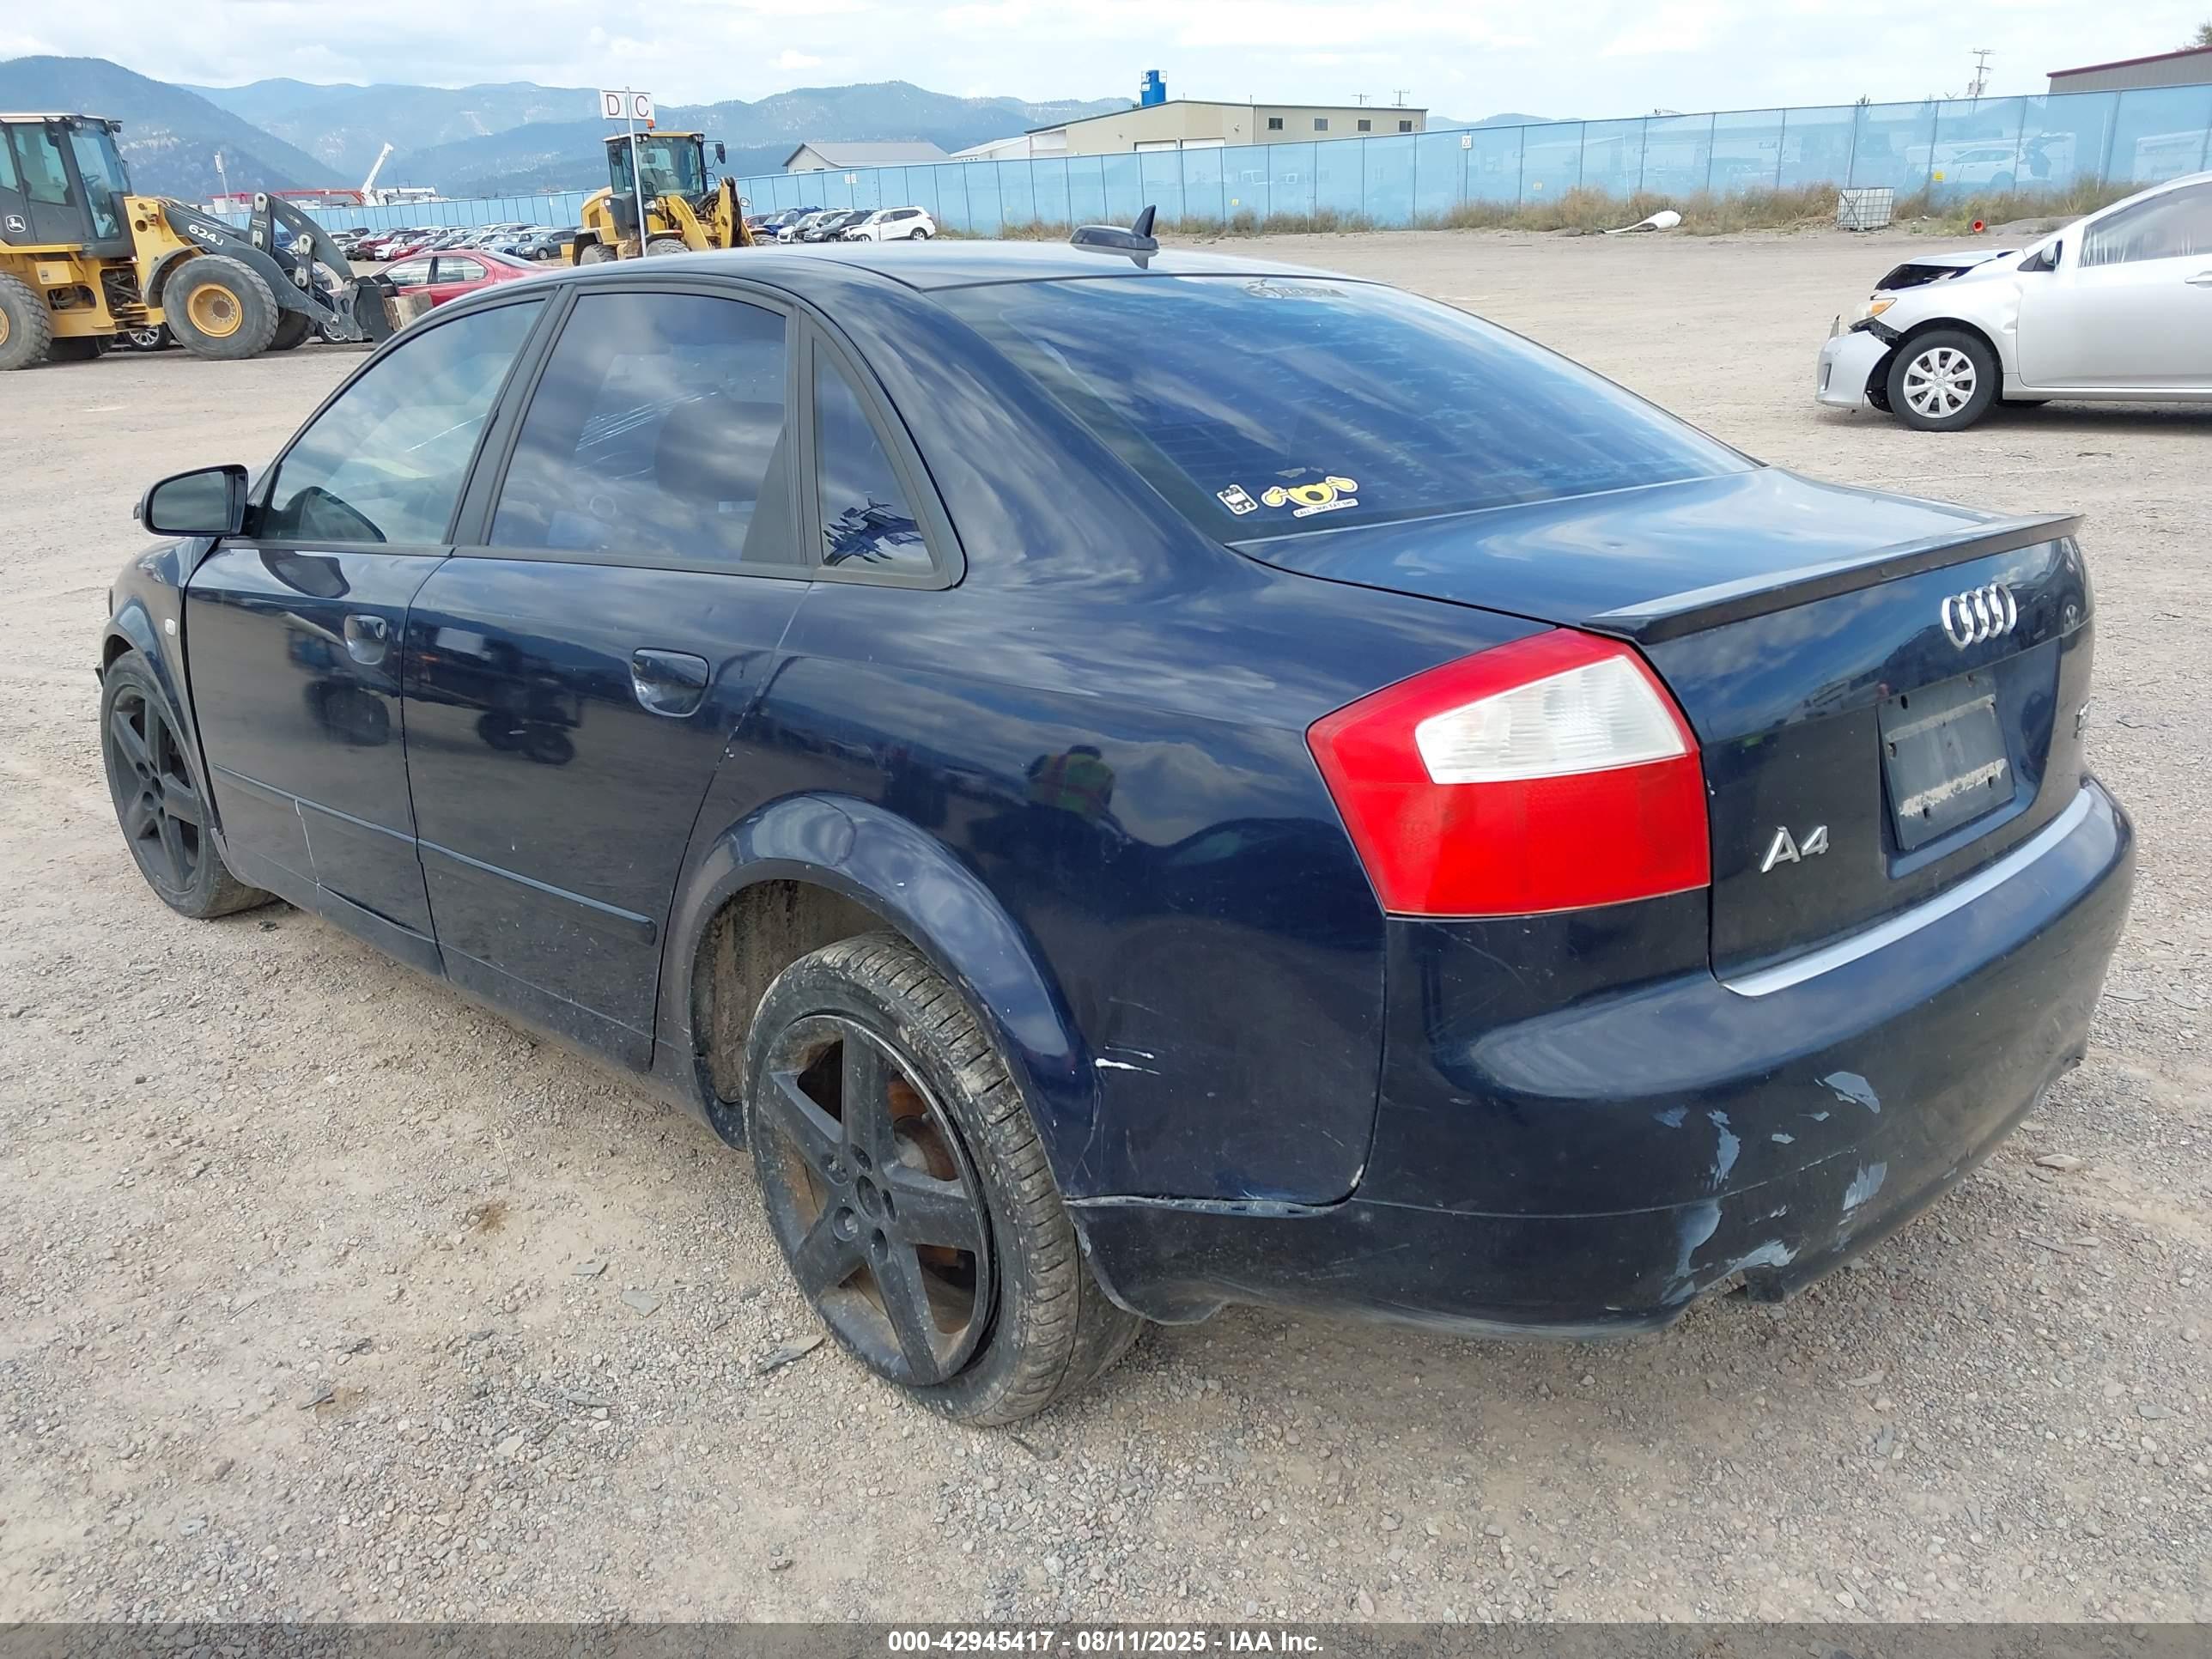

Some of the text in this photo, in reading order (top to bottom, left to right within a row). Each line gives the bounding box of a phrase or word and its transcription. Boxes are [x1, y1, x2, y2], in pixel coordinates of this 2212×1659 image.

[605, 94, 620, 116] D
[635, 94, 649, 118] C
[188, 224, 224, 246] 624J
[1759, 824, 1829, 873] A4
